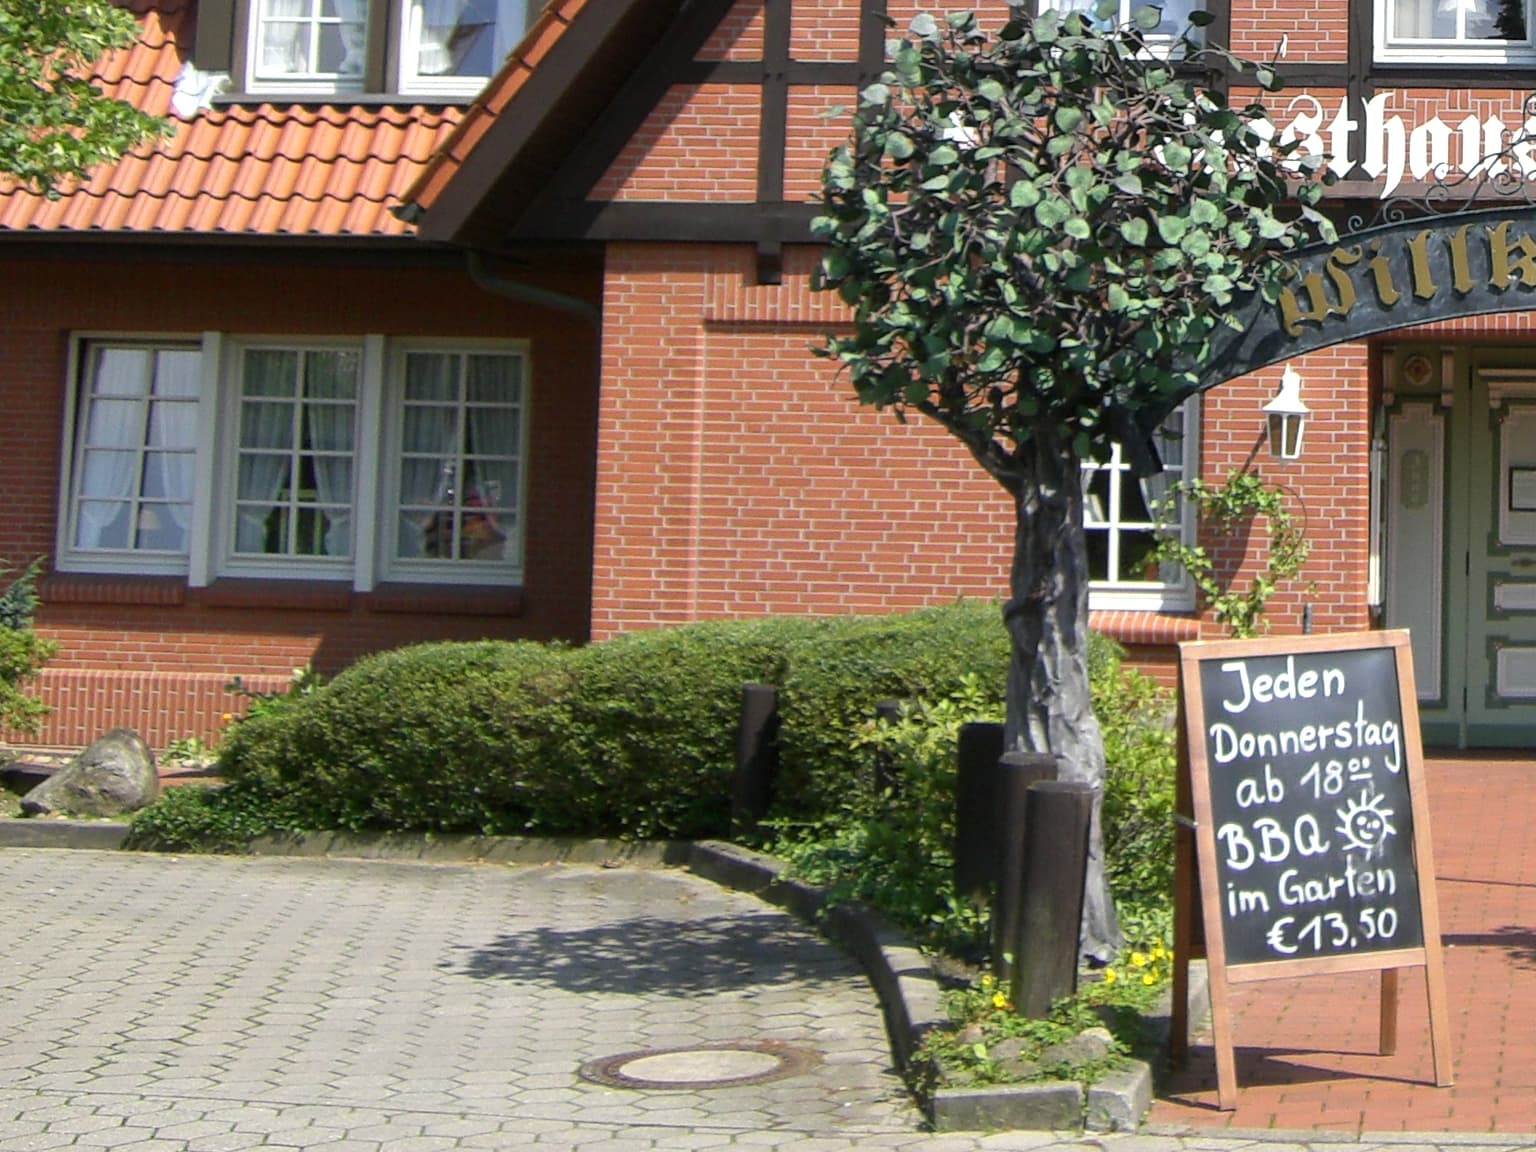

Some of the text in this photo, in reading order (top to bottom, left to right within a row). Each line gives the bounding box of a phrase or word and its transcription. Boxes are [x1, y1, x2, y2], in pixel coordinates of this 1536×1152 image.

[1221, 655, 1346, 714] Jeden
[1209, 699, 1402, 774] Donnerstag
[1236, 763, 1285, 808] ab
[1217, 814, 1331, 871] BBQ
[1227, 854, 1397, 917] im Garten
